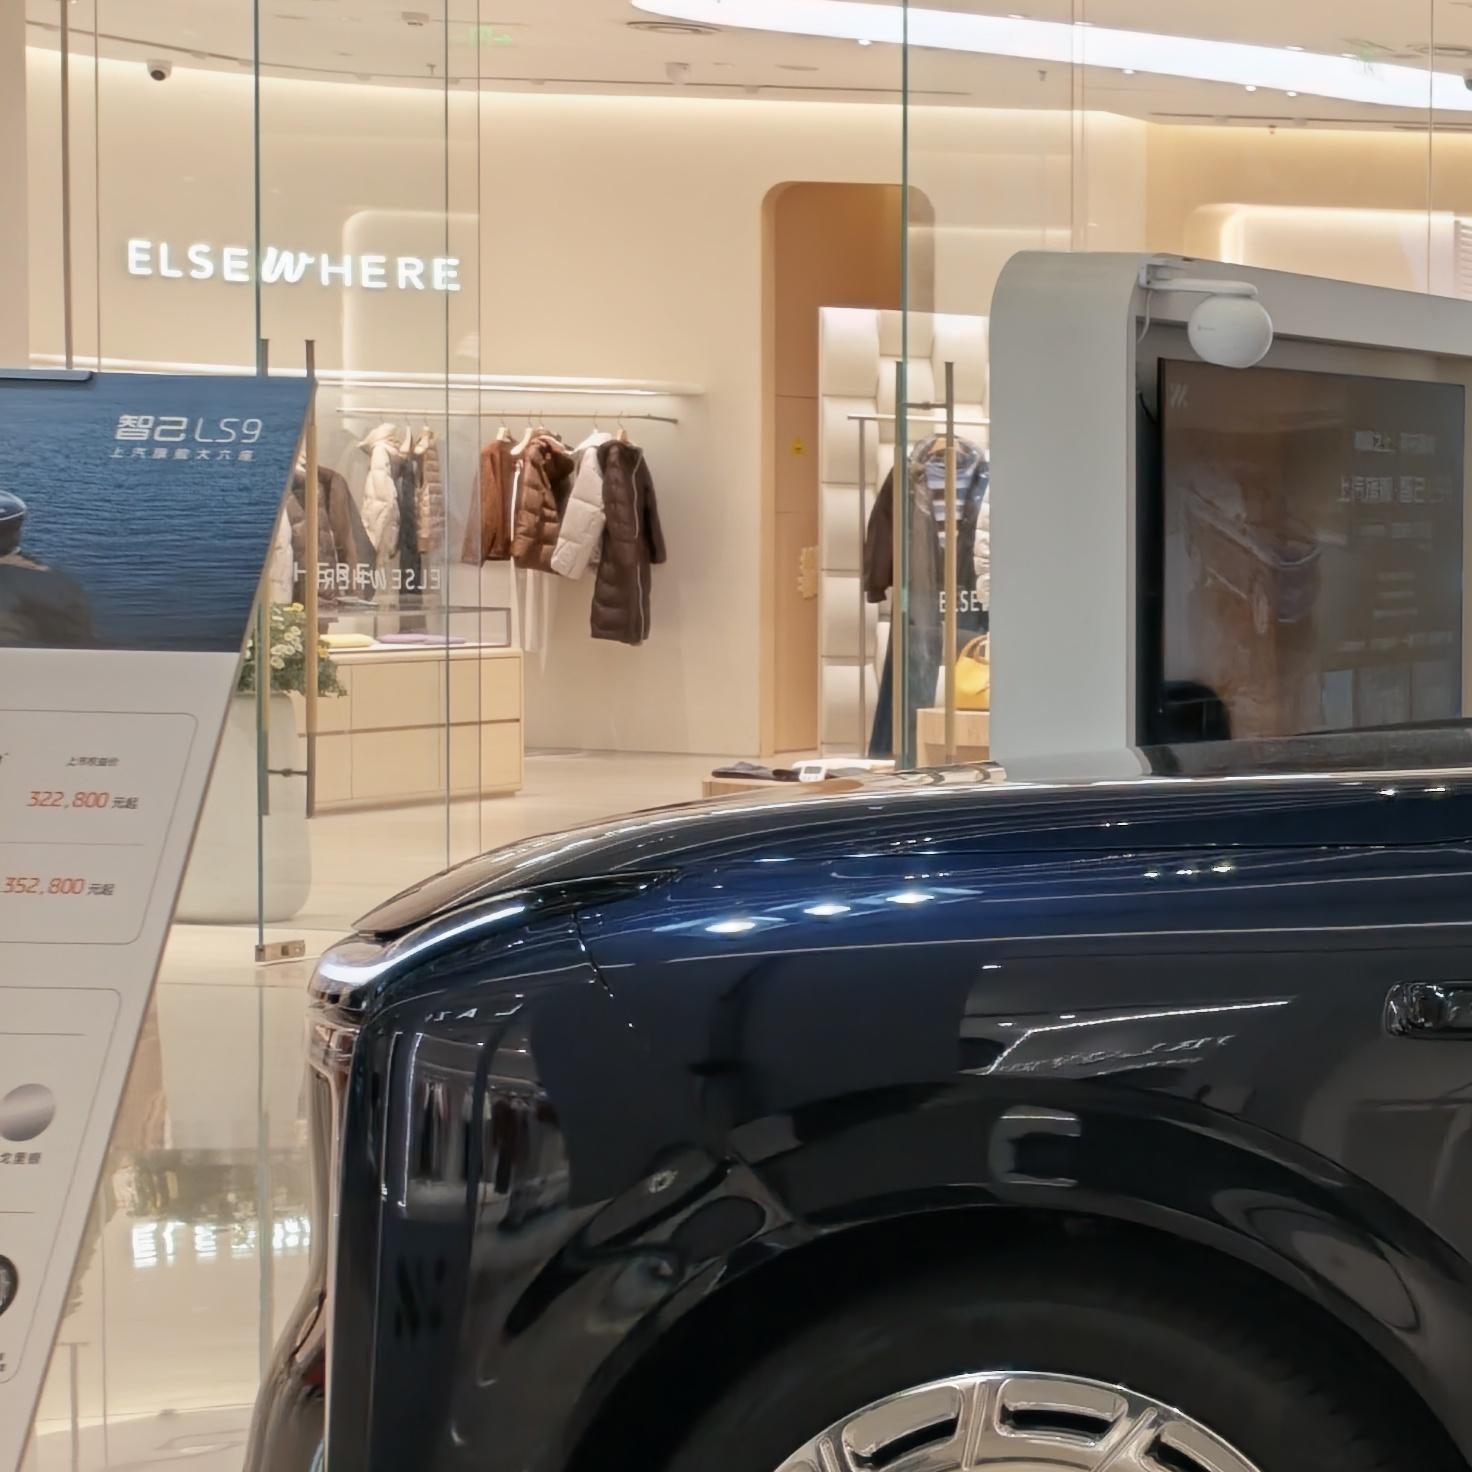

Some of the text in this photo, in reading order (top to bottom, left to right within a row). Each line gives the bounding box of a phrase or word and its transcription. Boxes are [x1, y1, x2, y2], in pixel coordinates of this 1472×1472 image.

[127, 239, 461, 291] ELSEWHERE
[26, 790, 110, 810] 322,800
[0, 876, 86, 896] 352,800
